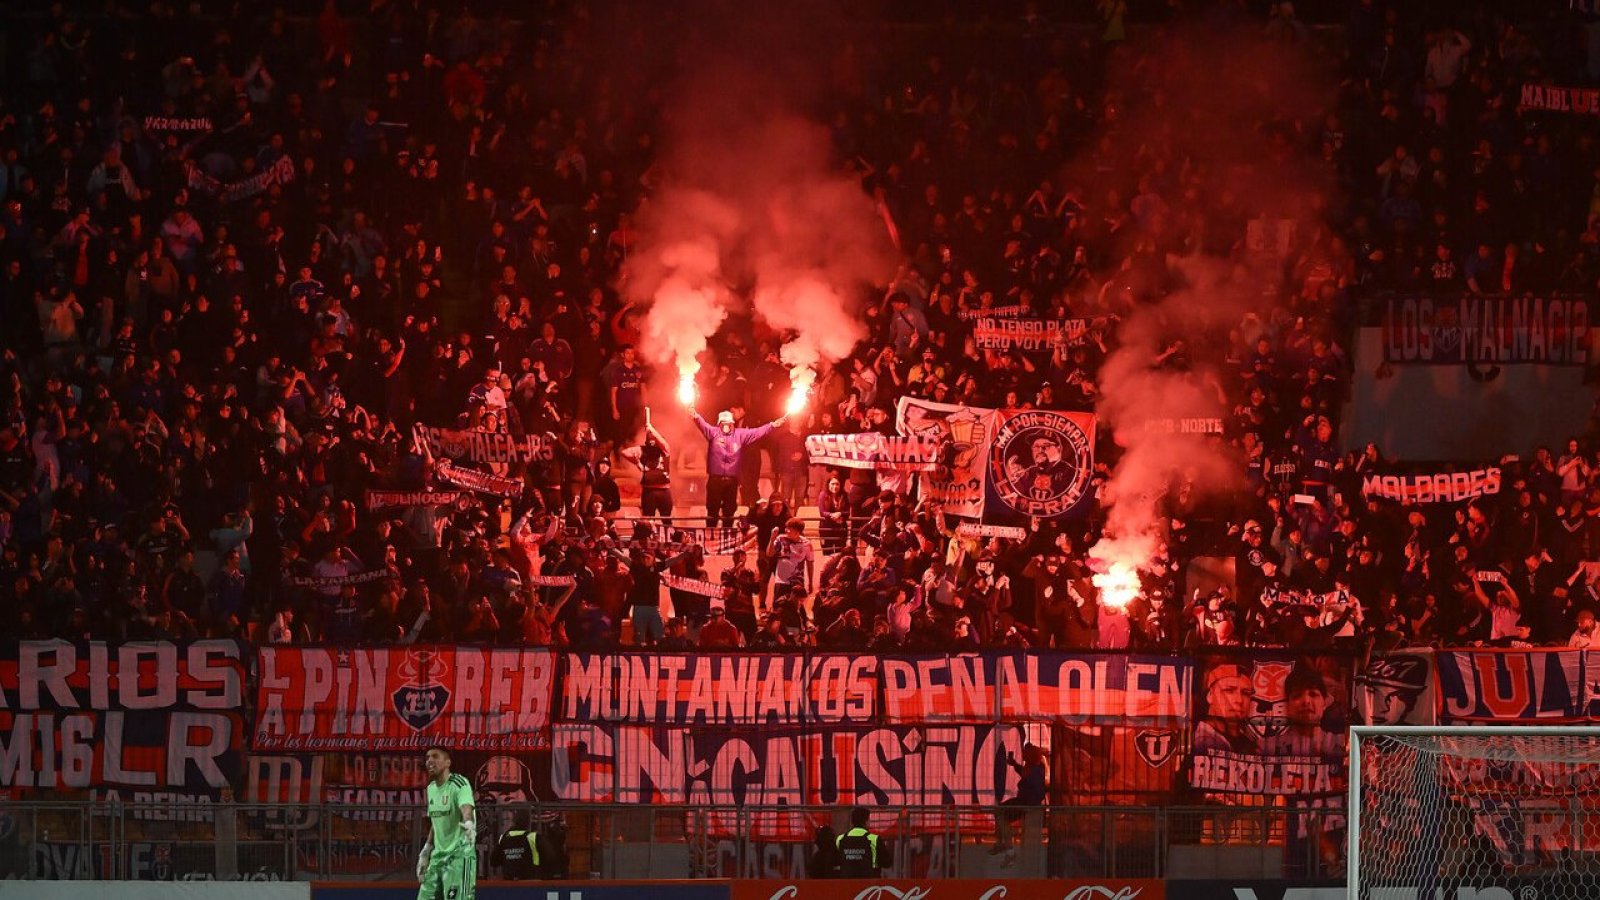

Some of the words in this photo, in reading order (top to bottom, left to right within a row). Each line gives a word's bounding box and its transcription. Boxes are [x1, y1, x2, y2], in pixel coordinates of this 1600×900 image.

[976, 334, 1010, 349] PERO
[1388, 299, 1435, 360] LOS
[1011, 412, 1039, 431] POR
[1180, 418, 1222, 433] NORTE
[469, 431, 518, 463] TALCA
[1144, 735, 1171, 761] U
[1191, 755, 1332, 795] REKOLETA
[133, 791, 215, 823] REINA
